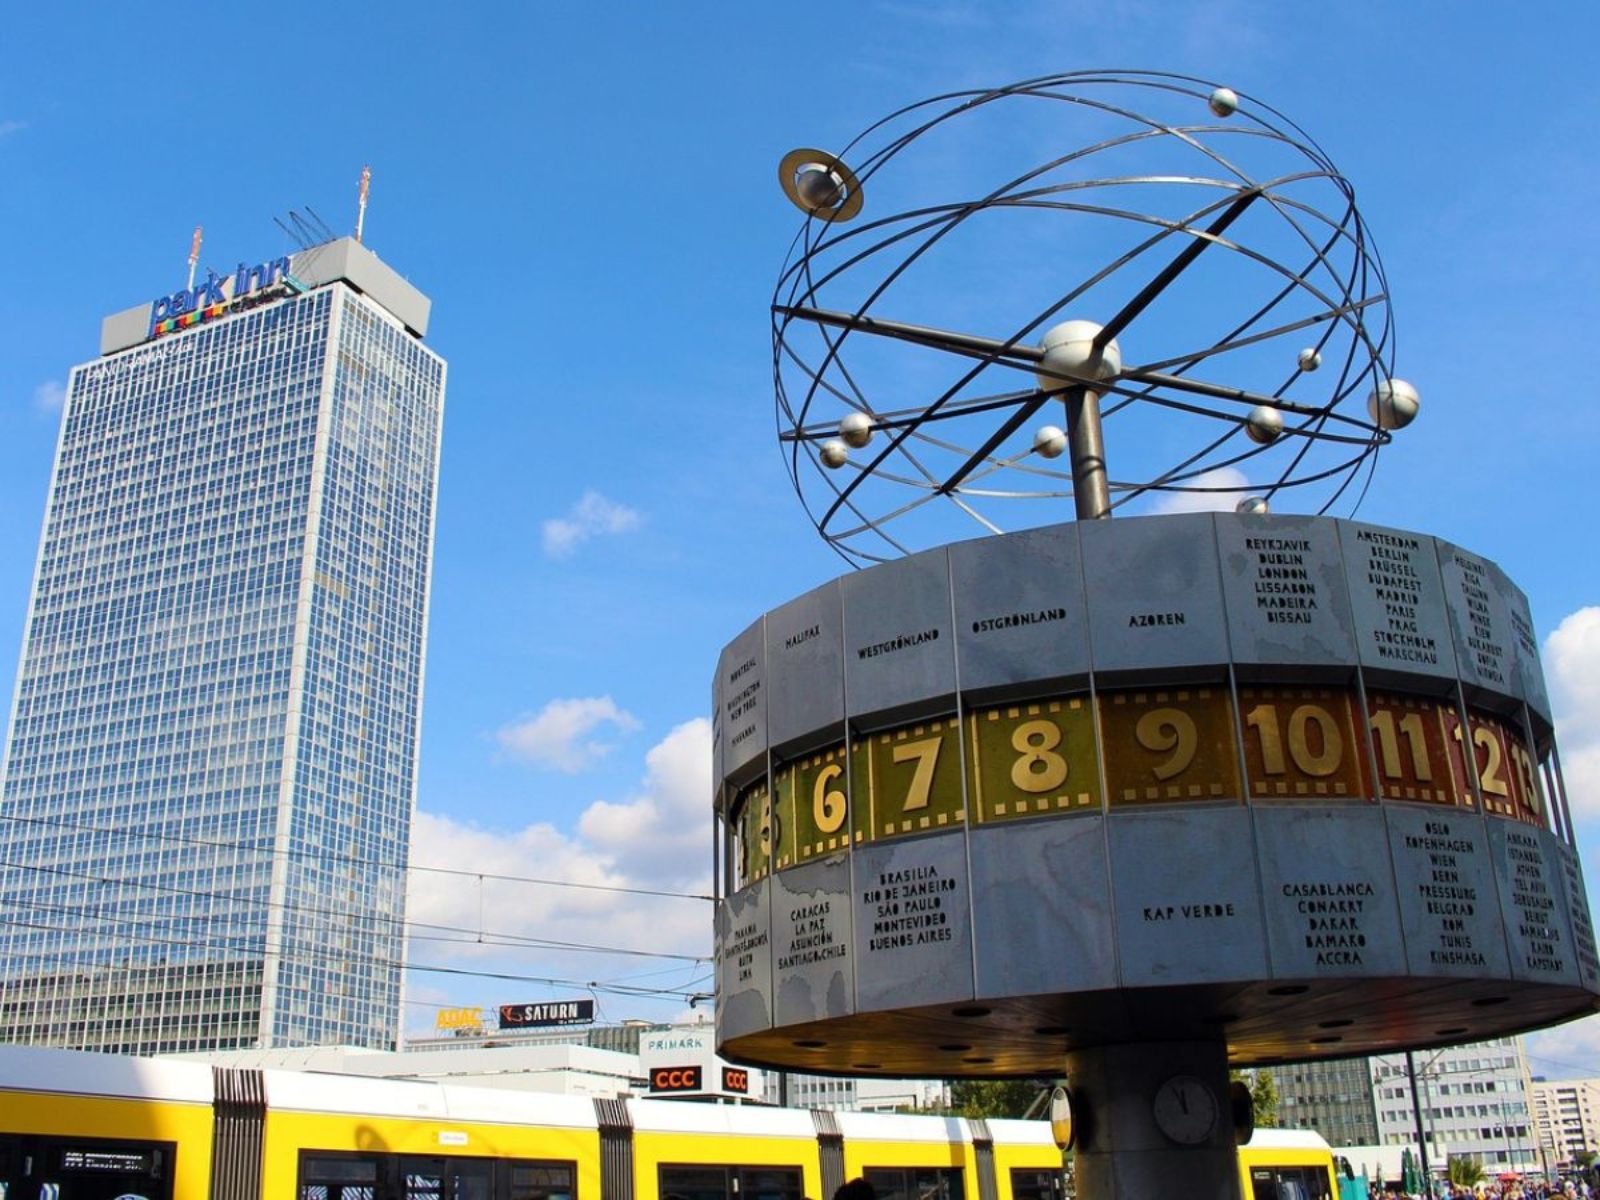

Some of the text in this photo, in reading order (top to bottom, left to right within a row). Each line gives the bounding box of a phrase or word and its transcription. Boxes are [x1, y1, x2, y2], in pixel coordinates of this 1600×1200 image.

[148, 271, 228, 340] park
[234, 256, 291, 298] inn
[1246, 538, 1312, 552] REYKJAVIK
[1357, 530, 1419, 550] AMSTERDAM
[1259, 554, 1303, 565] DUBLIN
[1371, 546, 1409, 562] BERLIN
[1258, 568, 1307, 580] LONDON
[1255, 582, 1315, 594] LISSABON
[1368, 573, 1422, 592] BUDAPEST
[1257, 597, 1318, 609] MADEIRA
[1376, 588, 1419, 605] MADRID
[1267, 611, 1311, 624] BISSAU
[1385, 603, 1415, 618] PARIS
[1128, 612, 1185, 628] AZOREN
[1388, 618, 1417, 633] PRAG
[785, 624, 820, 650] HALIFAX
[1374, 630, 1436, 651] STOCKHOLM
[1378, 645, 1437, 664] WARSCHAU
[813, 764, 848, 833] 6
[893, 736, 943, 812] 7
[1011, 719, 1068, 794] 8
[1135, 708, 1198, 781] 9
[1247, 704, 1344, 777] 10
[1369, 709, 1433, 782] 11
[1425, 822, 1450, 835] OSLO
[1405, 836, 1474, 853] KOPENHAGEN
[1430, 854, 1456, 867] WIEN
[880, 865, 938, 885] BRASILIA
[1432, 870, 1458, 883] BERN
[864, 878, 956, 904] RIO DE JANEIRO
[1283, 883, 1374, 896] CASABLANCA
[1419, 884, 1476, 900] PRESSBURG
[791, 902, 829, 921] CARACAS
[905, 897, 941, 912] PAULO
[1143, 903, 1235, 921] KAP VERDE
[1298, 900, 1364, 913] CONAKRY
[1427, 901, 1474, 916] BELGRAD
[796, 919, 825, 936] LA PAZ
[874, 912, 946, 934] MONTEVIDEO
[1309, 918, 1359, 930] DAKAR
[1443, 919, 1464, 931] ROM
[870, 928, 951, 951] BUENOS AIRES
[1306, 935, 1366, 948] BAMAKO
[1440, 935, 1472, 949] TUNIS
[1316, 952, 1362, 965] ACCRA
[1430, 950, 1487, 966] KINSHASA
[524, 1002, 579, 1021] SATURN
[648, 1039, 702, 1050] PRIMARK
[655, 1070, 695, 1088] CCC
[726, 1071, 747, 1089] CCC
